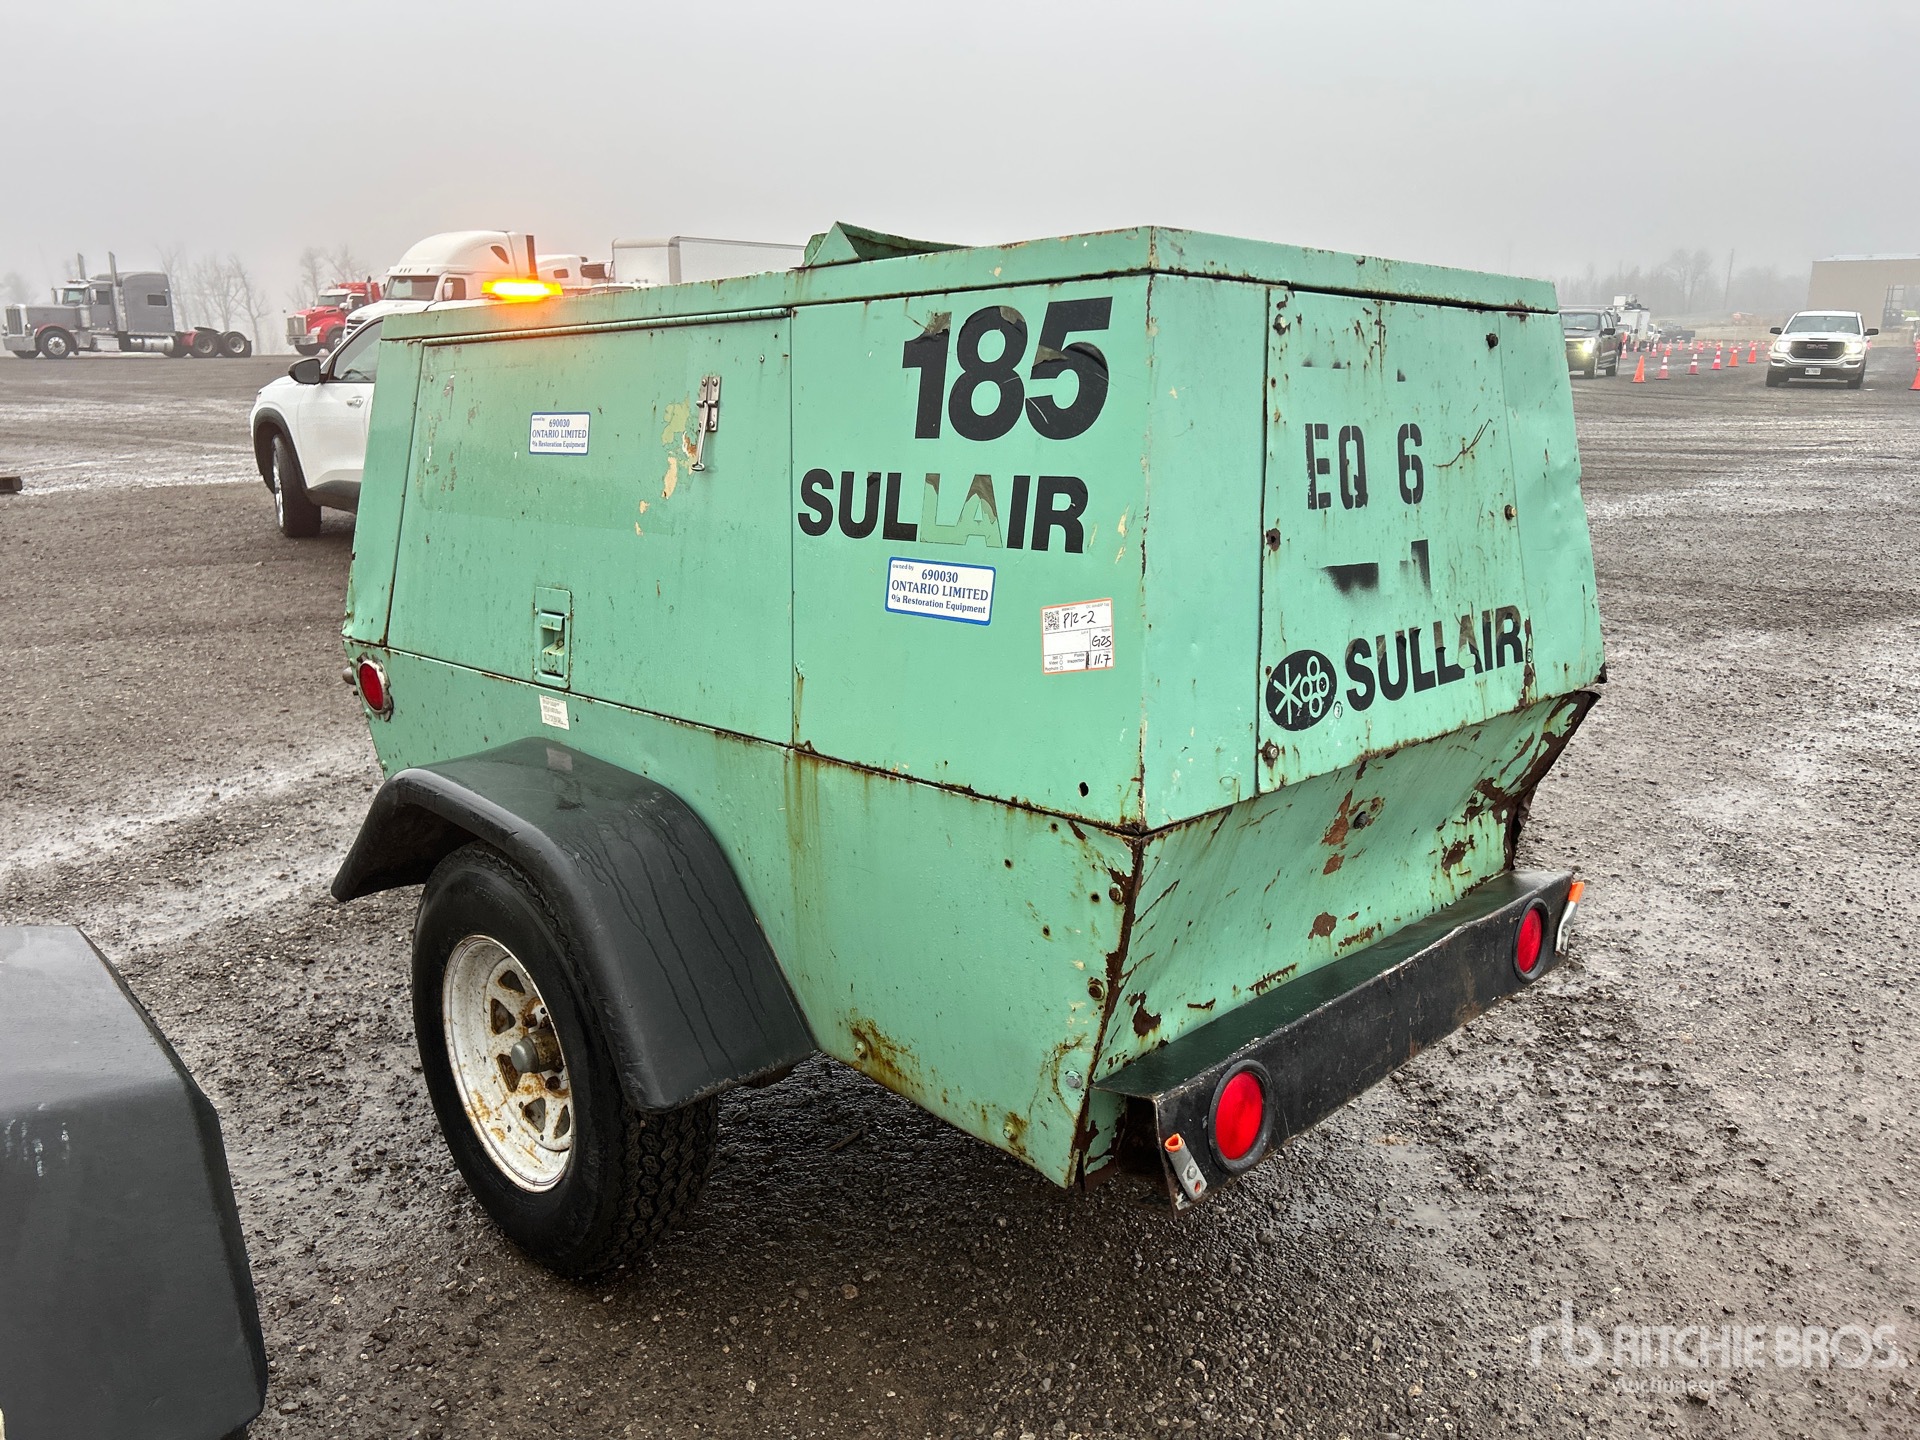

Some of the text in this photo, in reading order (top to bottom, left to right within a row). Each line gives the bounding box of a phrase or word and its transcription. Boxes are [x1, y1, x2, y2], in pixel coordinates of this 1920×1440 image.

[902, 297, 1113, 441] 185
[532, 429, 587, 438] ONTARIO LIMITED
[549, 419, 571, 428] 690030
[562, 440, 586, 449] Equipment
[1305, 423, 1424, 510] EQ 6
[798, 468, 1088, 554] SULLAIR
[921, 568, 959, 584] 690030
[891, 579, 989, 602] ONTARIO LIMITED
[902, 595, 944, 609] Restoration
[946, 600, 986, 614] Equipment
[1345, 604, 1525, 712] SULLAIR
